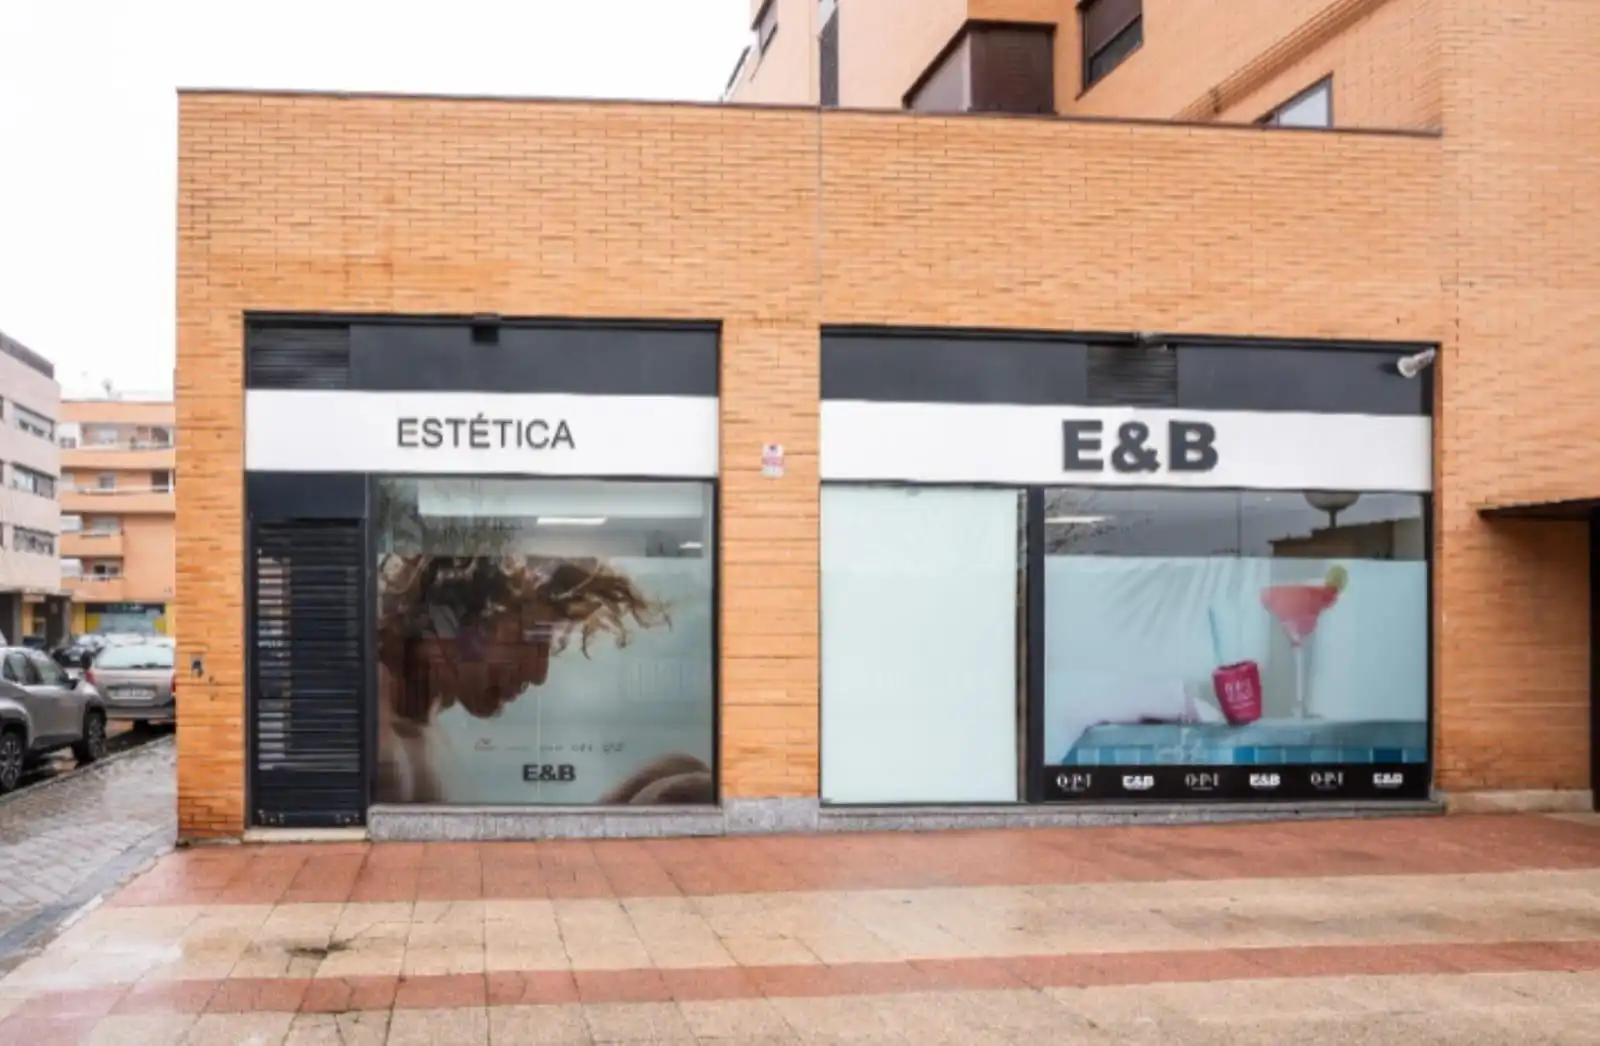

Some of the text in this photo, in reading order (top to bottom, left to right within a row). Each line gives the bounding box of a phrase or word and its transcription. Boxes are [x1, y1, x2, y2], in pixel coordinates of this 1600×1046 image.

[397, 412, 576, 450] ESTÉTICA
[1062, 419, 1219, 473] E&B
[522, 763, 576, 782] E&B
